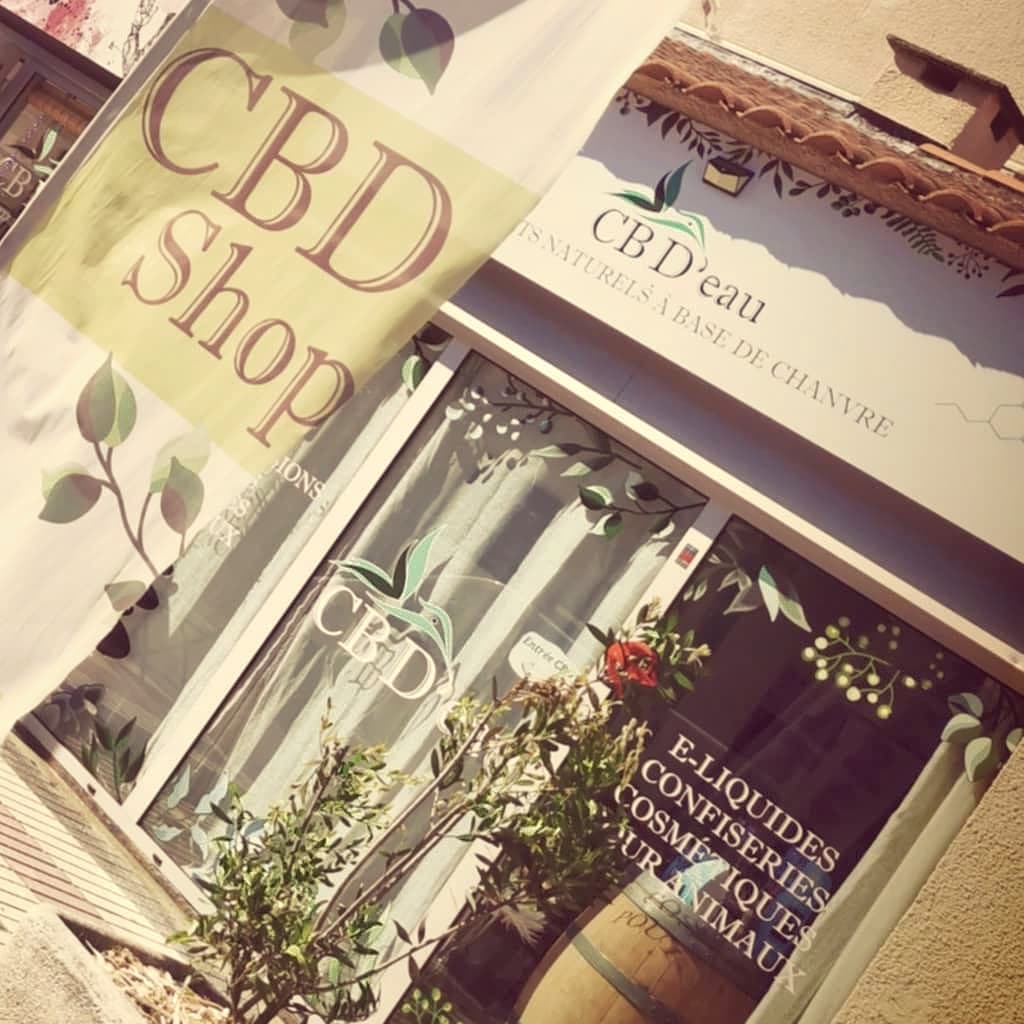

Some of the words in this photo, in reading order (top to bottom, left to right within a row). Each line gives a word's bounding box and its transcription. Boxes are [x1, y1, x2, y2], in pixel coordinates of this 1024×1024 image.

[139, 47, 455, 293] CBD
[122, 209, 356, 449] Shop
[542, 233, 653, 304] NATURELS
[671, 304, 730, 349] BASE
[732, 337, 772, 370] DE
[769, 359, 896, 439] CHANVRE
[608, 826, 666, 877] UR
[641, 759, 832, 914] CONFISERIES
[668, 734, 841, 872] E-LIQUIDES
